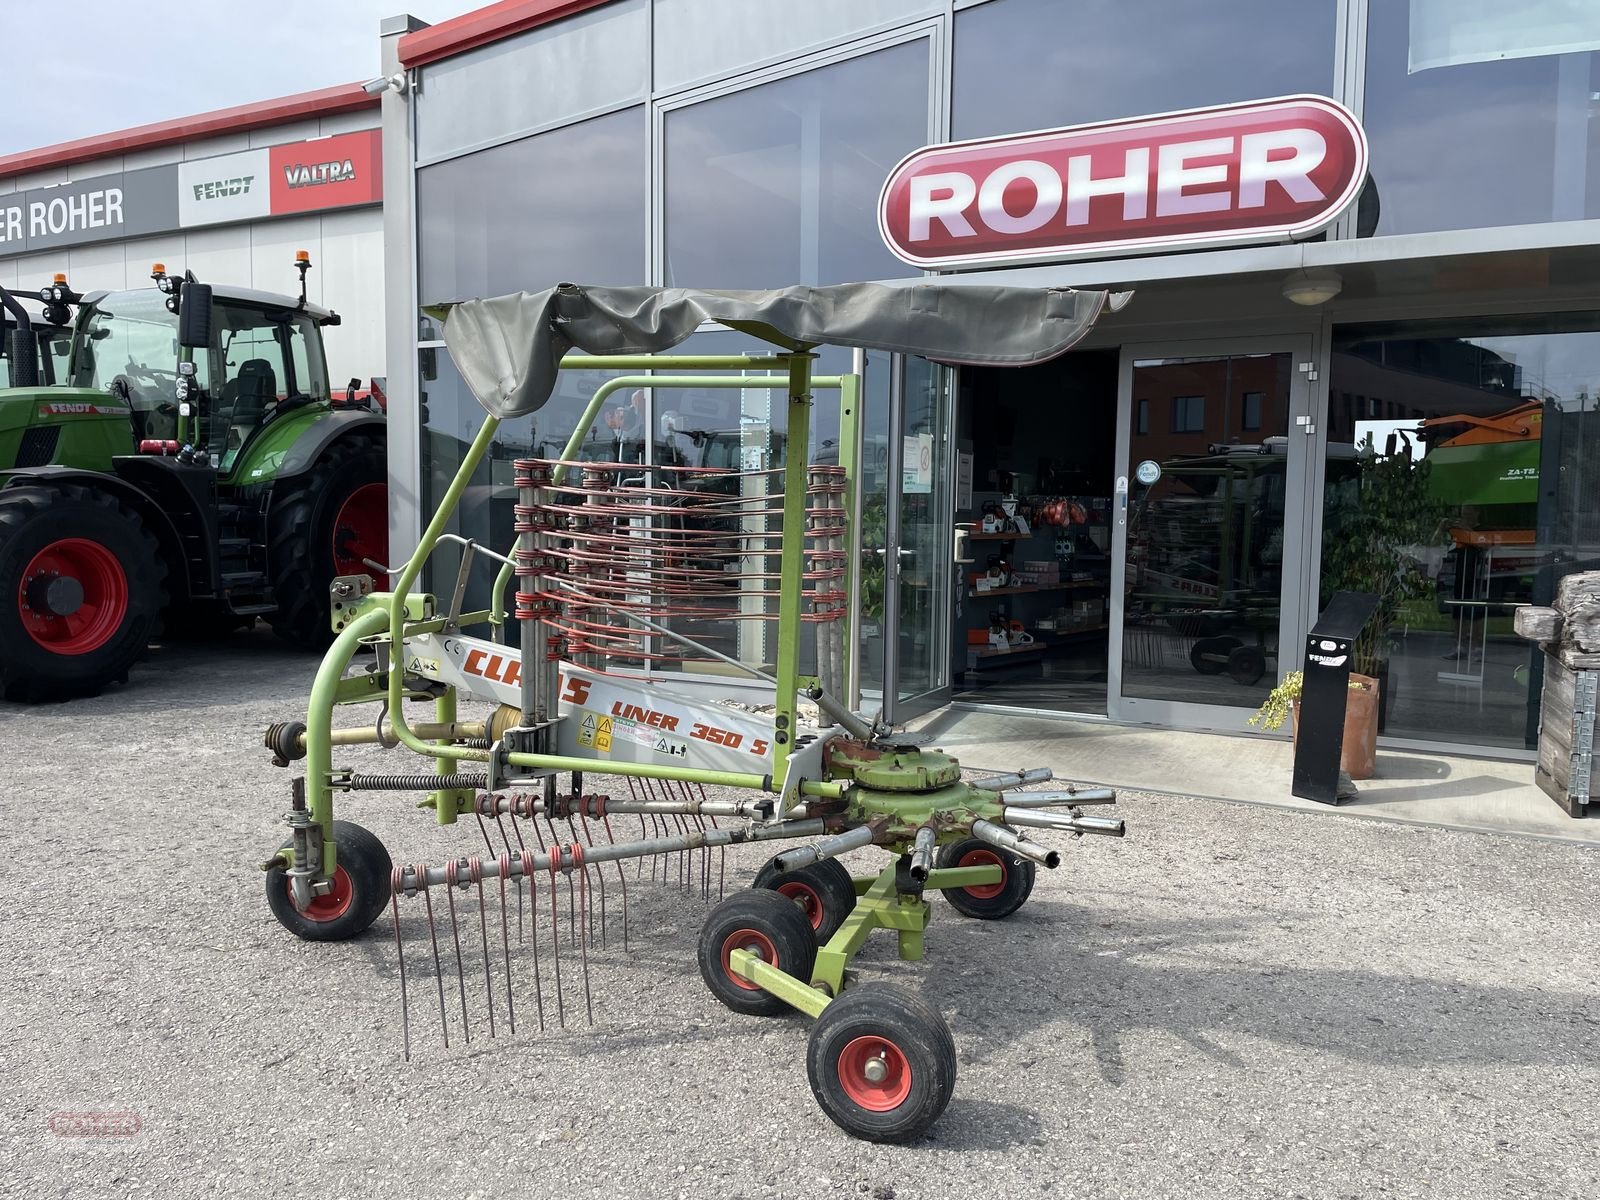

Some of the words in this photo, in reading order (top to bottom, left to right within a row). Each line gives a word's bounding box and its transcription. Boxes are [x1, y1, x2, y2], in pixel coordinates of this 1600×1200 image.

[193, 176, 255, 201] FENDT
[284, 159, 355, 189] VALTRA
[908, 128, 1328, 243] ROHER
[30, 188, 124, 237] ROHER
[49, 403, 92, 413] FENDT
[463, 649, 592, 705] CLAS
[611, 701, 679, 732] LINER
[689, 723, 743, 749] 350
[750, 739, 769, 756] S
